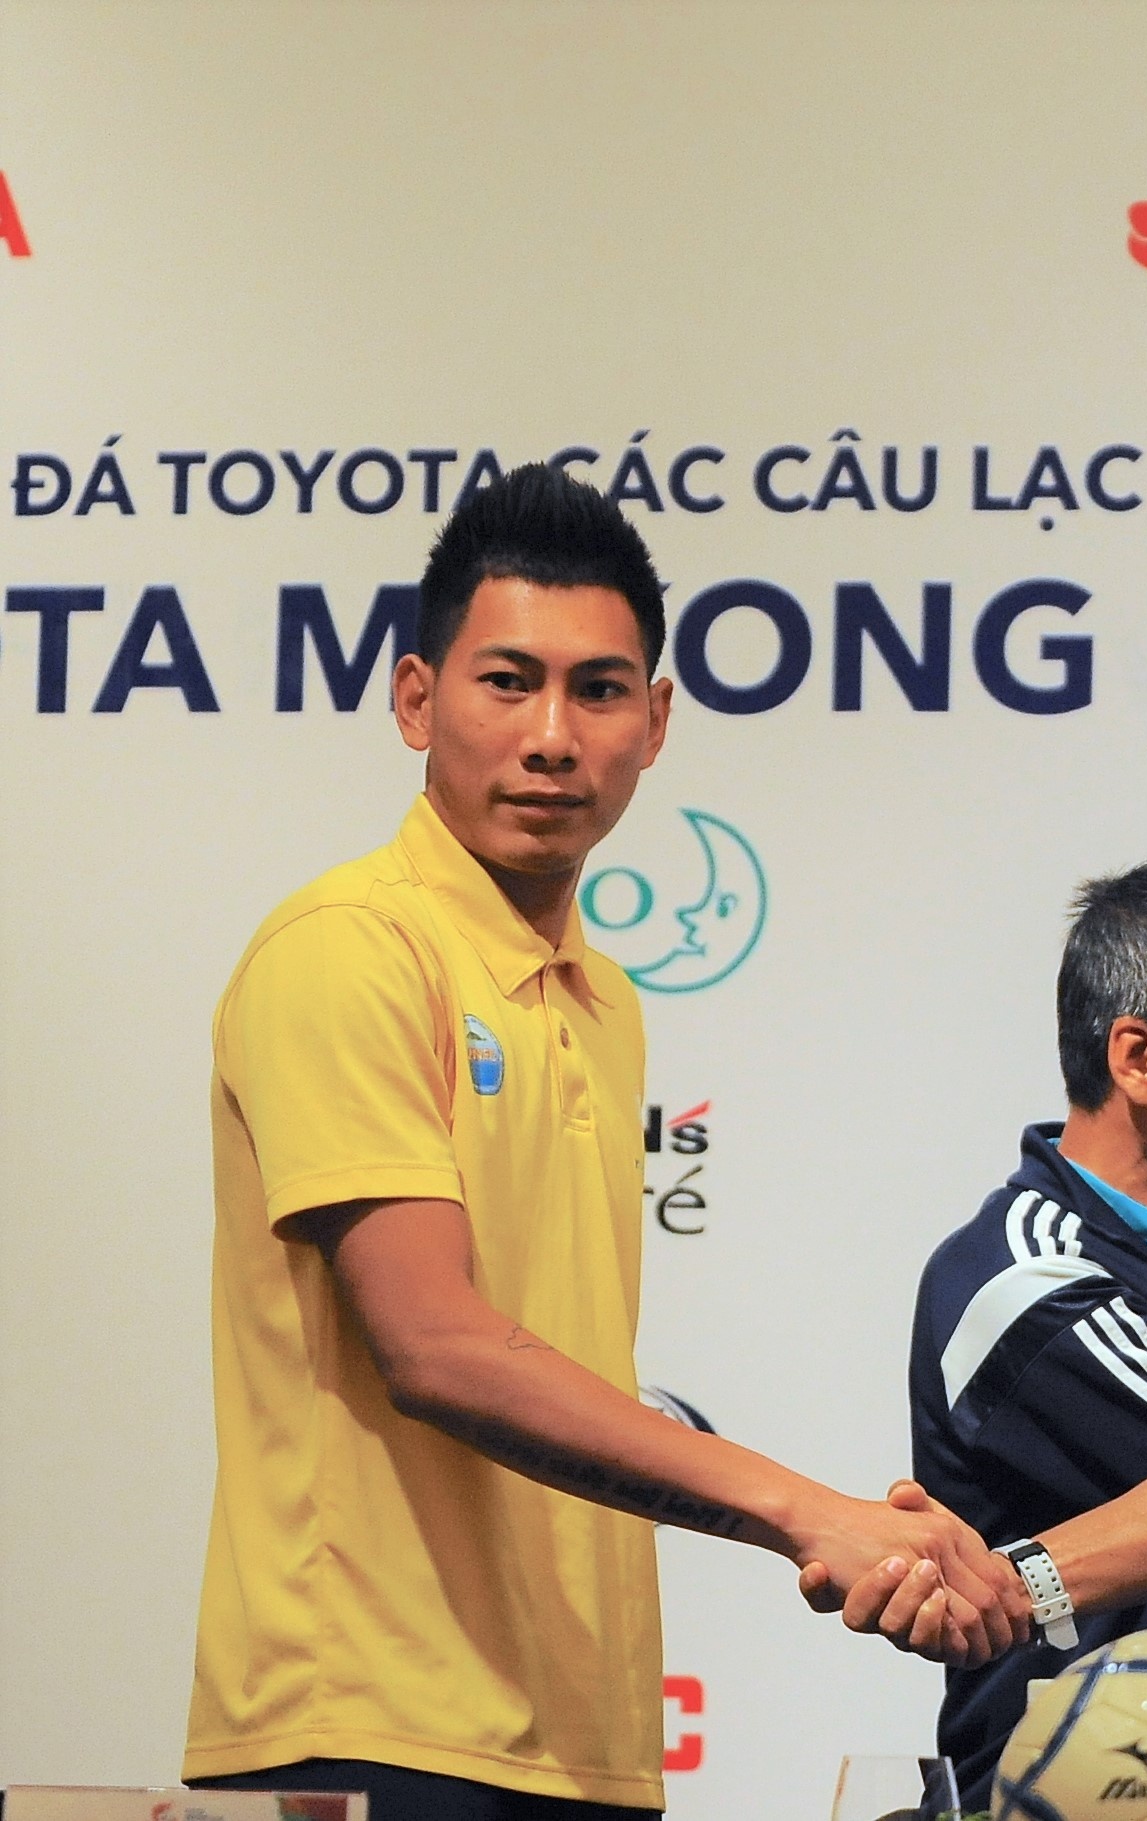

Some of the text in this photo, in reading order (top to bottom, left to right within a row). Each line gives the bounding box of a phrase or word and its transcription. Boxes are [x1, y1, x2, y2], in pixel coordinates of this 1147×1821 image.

[11, 434, 137, 517] ĐÁ
[157, 446, 508, 517] TOYOTA
[753, 427, 939, 515] CÂU
[972, 443, 1144, 533] LẠC
